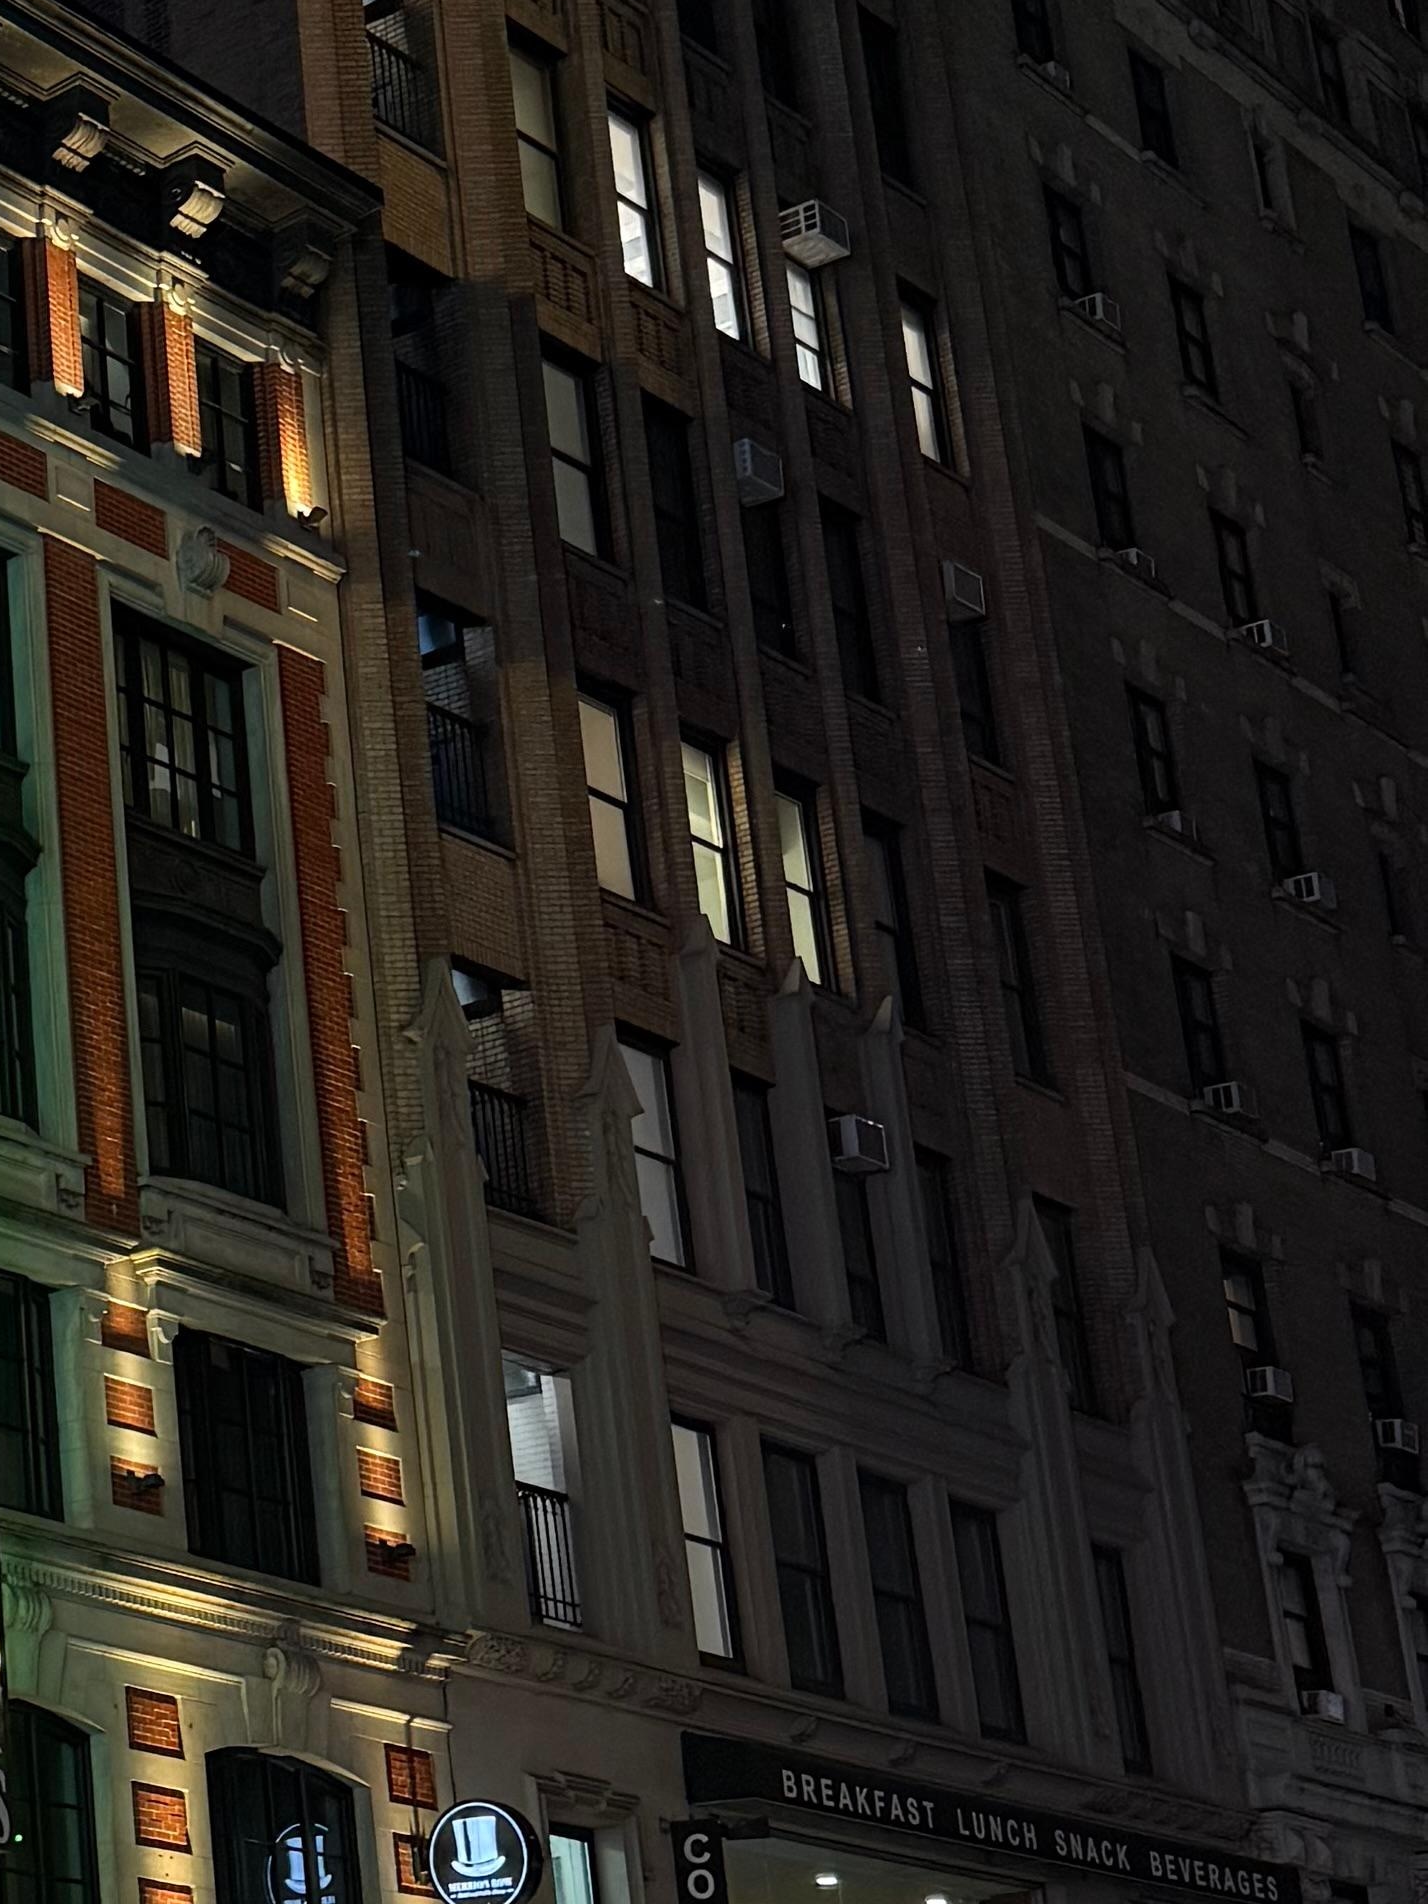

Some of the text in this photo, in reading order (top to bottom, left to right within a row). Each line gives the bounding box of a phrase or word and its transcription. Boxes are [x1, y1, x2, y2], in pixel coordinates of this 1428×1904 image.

[780, 1768, 1278, 1902] BREAKFAST LUNCH SNACK BEVERAGES
